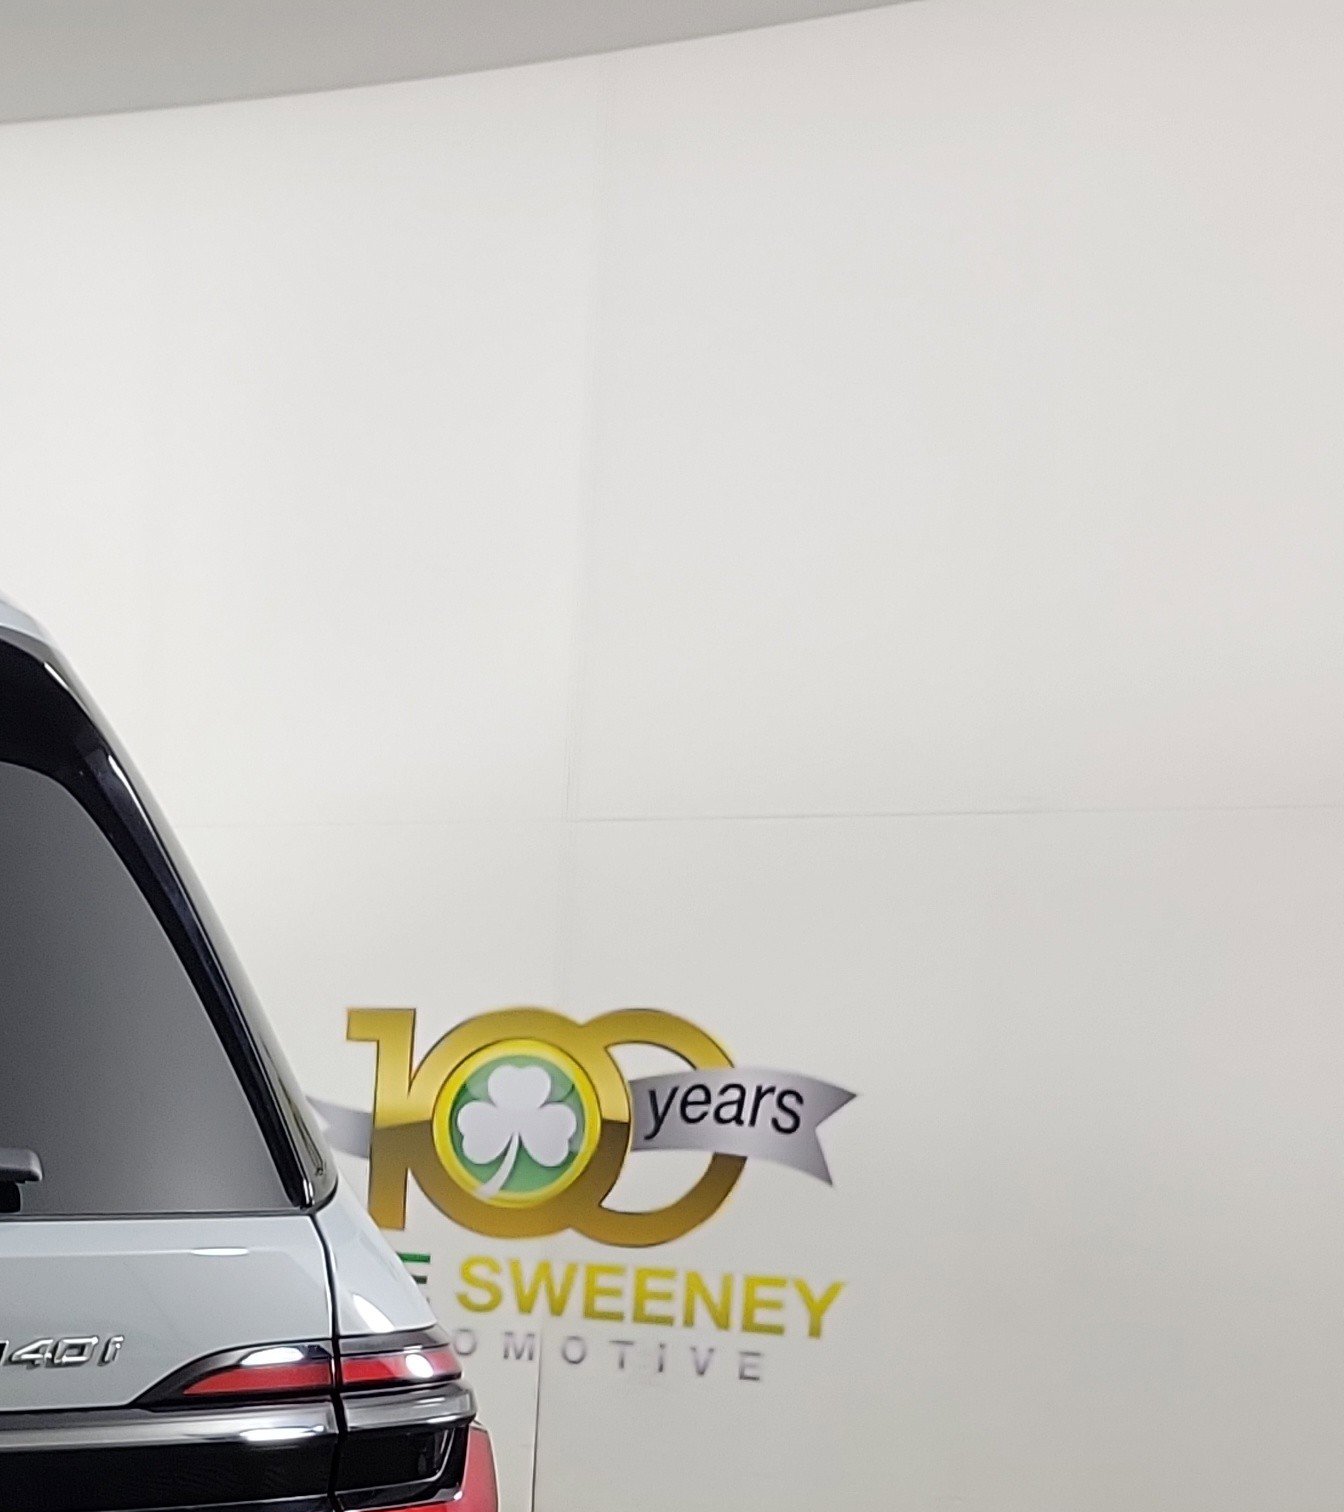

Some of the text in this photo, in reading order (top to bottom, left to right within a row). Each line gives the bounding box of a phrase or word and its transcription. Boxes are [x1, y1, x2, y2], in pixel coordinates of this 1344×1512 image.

[345, 1006, 805, 1248] 100 years
[455, 1254, 848, 1339] SWEENEY
[11, 1335, 125, 1367] 40i
[452, 1327, 768, 1382] OMOTIVE
